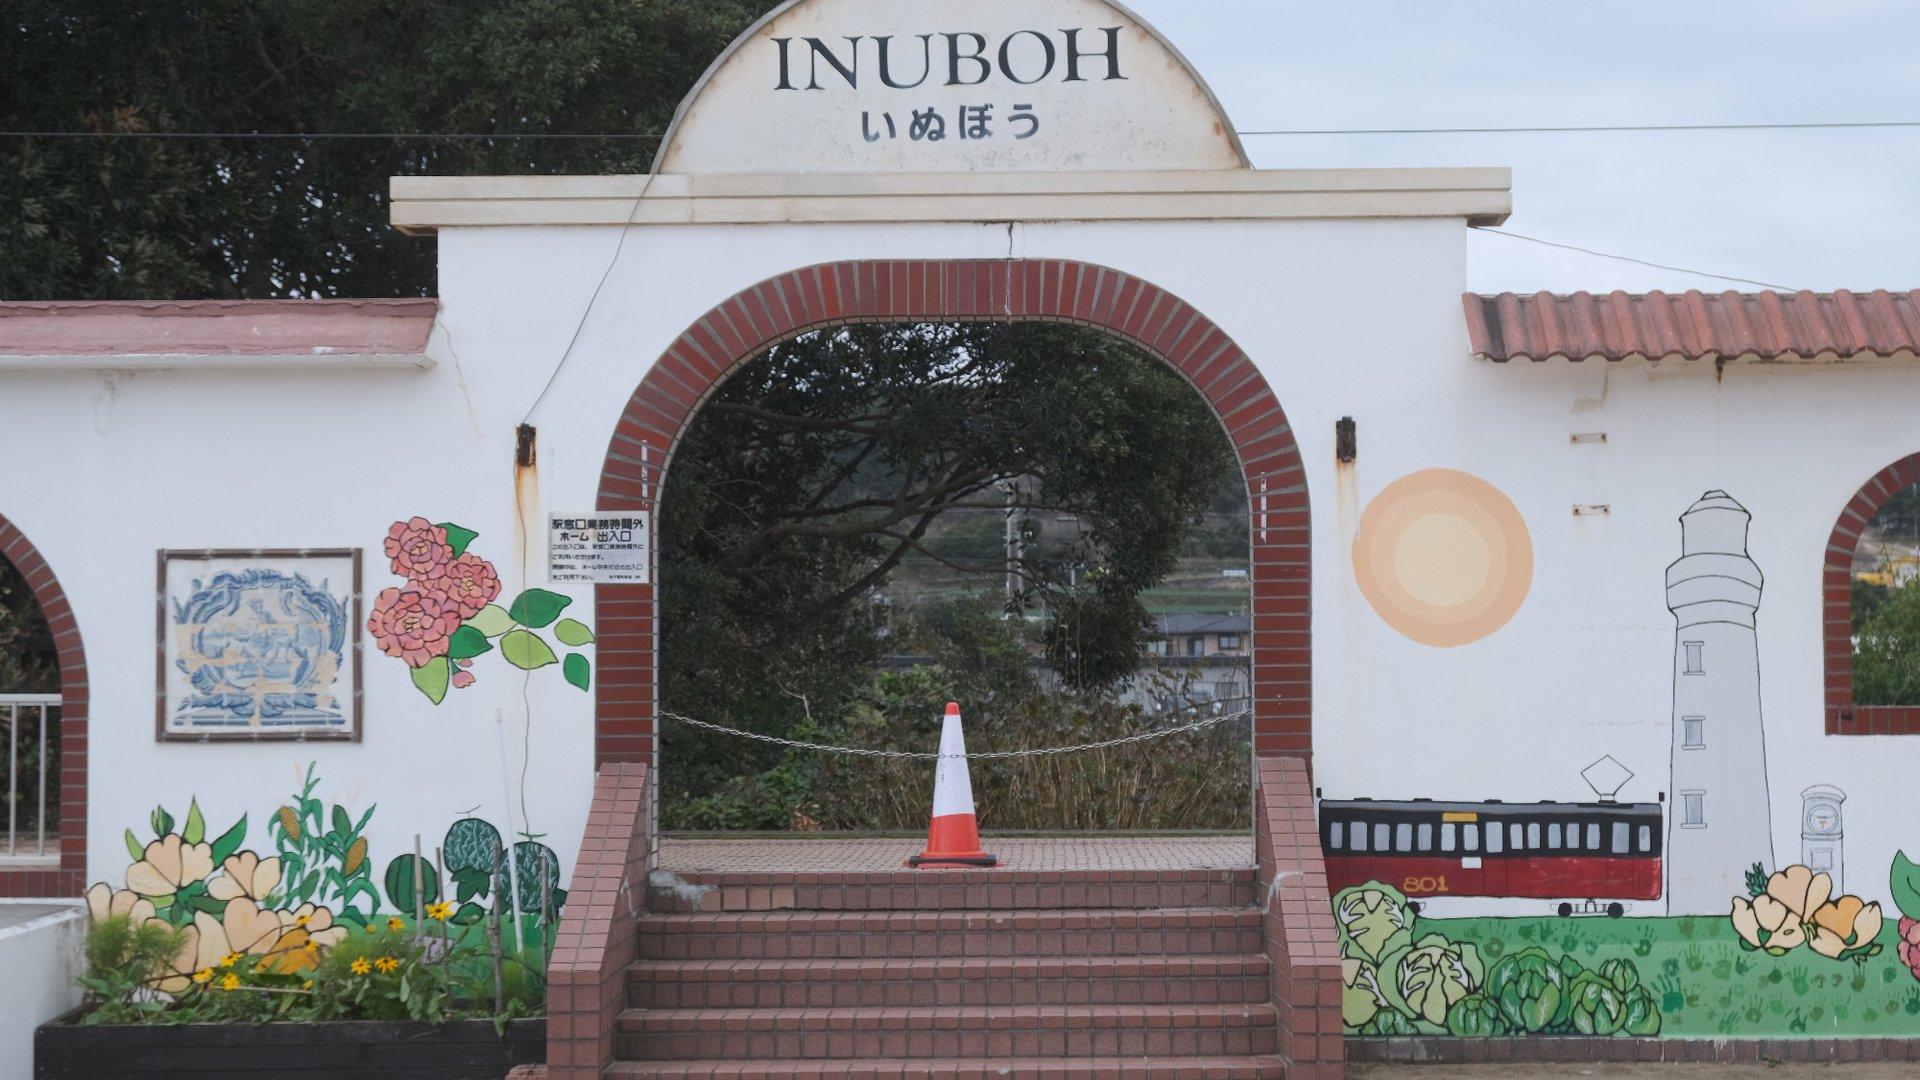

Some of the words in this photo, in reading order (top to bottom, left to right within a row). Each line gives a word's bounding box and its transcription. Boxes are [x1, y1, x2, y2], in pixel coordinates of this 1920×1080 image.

[770, 25, 1129, 91] INUBOH
[861, 103, 1040, 142] いぬぼう
[551, 518, 644, 531] 駅窓口業務時間外
[559, 531, 590, 542] ホーム
[596, 531, 632, 542] 出入口
[1404, 876, 1449, 892] 801
